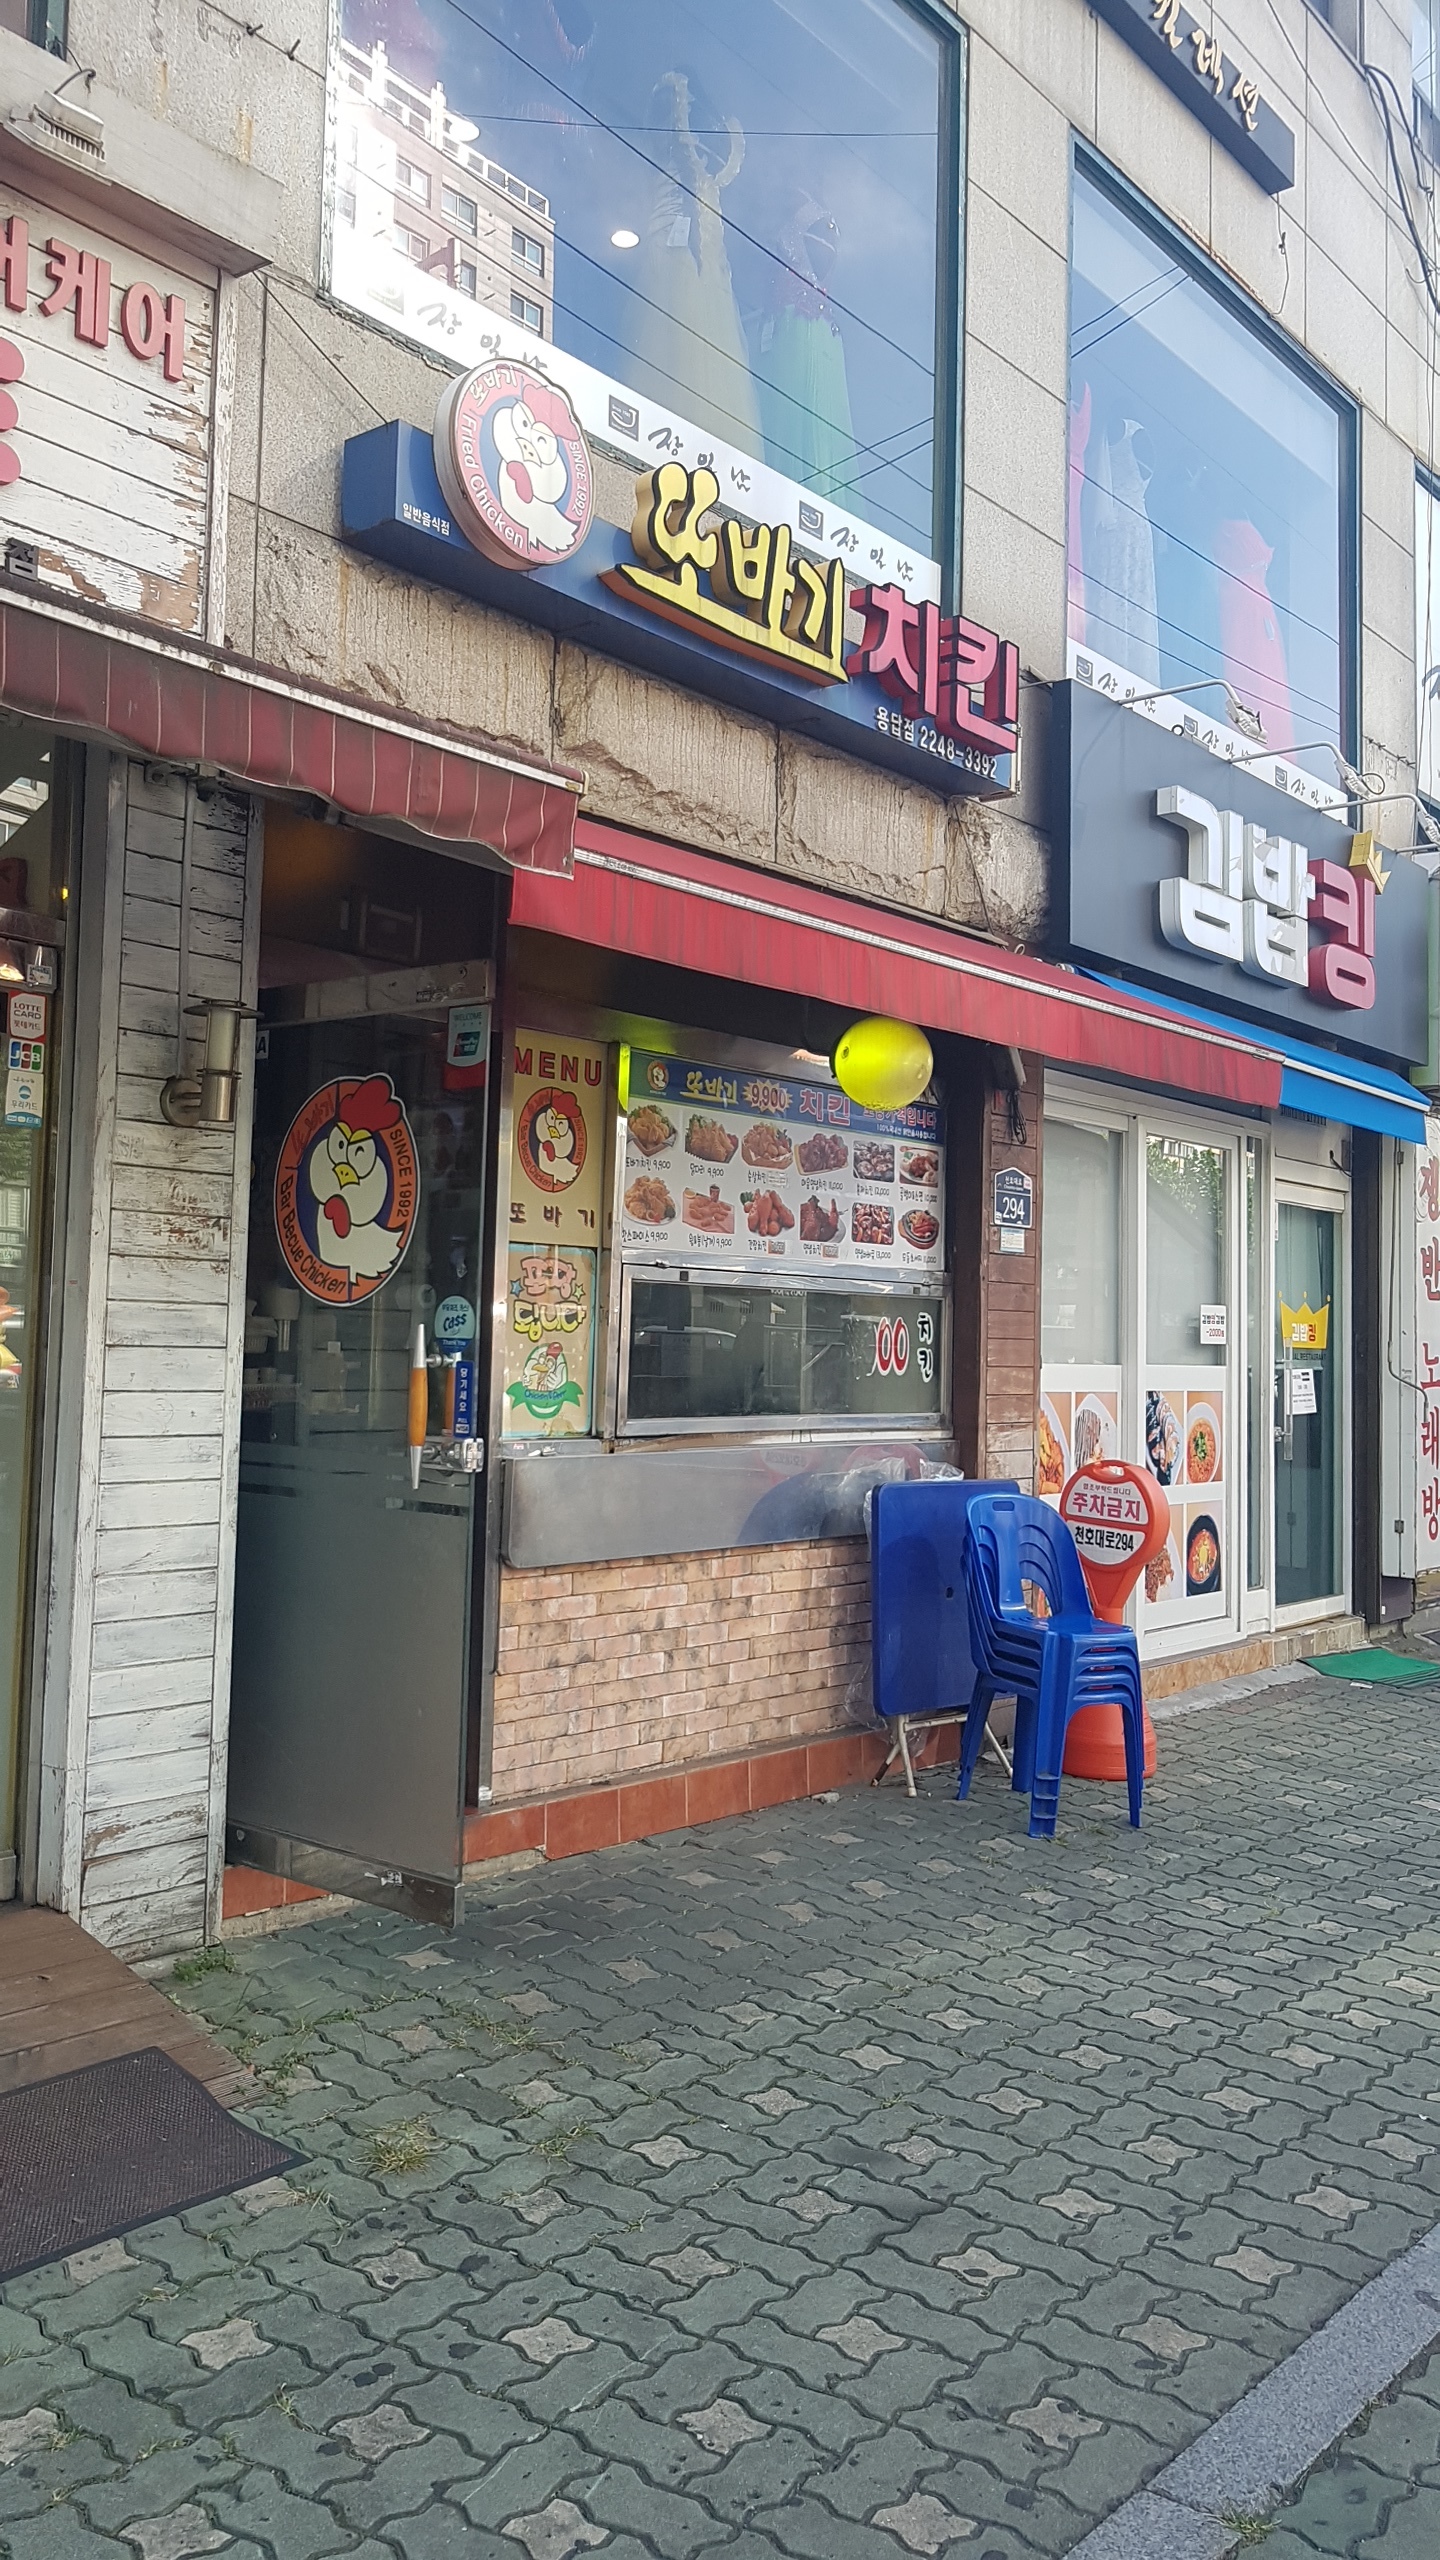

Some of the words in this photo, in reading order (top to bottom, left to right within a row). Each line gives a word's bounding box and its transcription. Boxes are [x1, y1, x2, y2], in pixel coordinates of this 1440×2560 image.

[461, 412, 480, 470] Fried
[569, 441, 587, 482] SINCE
[470, 474, 524, 549] Chicken
[573, 481, 588, 517] 1992
[402, 503, 450, 537] 일반음식점
[615, 461, 850, 684] 또바기
[852, 582, 1019, 752] 치킨
[876, 706, 915, 742] 용답점
[919, 726, 997, 778] 2248-3392
[1157, 785, 1376, 1010] 김밥킹
[13, 1002, 41, 1012] LOTTE
[13, 1010, 41, 1020] CARD
[514, 1046, 602, 1087] MENU
[680, 1071, 739, 1105] 또바기
[751, 1084, 787, 1109] 9,900
[799, 1088, 850, 1126] 치킨
[389, 1128, 412, 1177] SINCE
[652, 1159, 671, 1170] 9,900
[529, 1166, 552, 1187] Chicken
[707, 1167, 724, 1178] 9,900
[281, 1174, 293, 1213] Bar
[396, 1181, 412, 1217] 1992
[1002, 1196, 1025, 1220] 294
[282, 1209, 303, 1262] Becue
[650, 1231, 668, 1243] 9,900
[716, 1238, 732, 1249] 9,900
[300, 1252, 346, 1294] Chicken
[443, 1313, 468, 1332] Cass
[1291, 1323, 1317, 1342] 김밥킹
[917, 1312, 933, 1383] 치킨
[1072, 1492, 1141, 1521] 주차금지
[1075, 1525, 1134, 1551] 천호대로294
